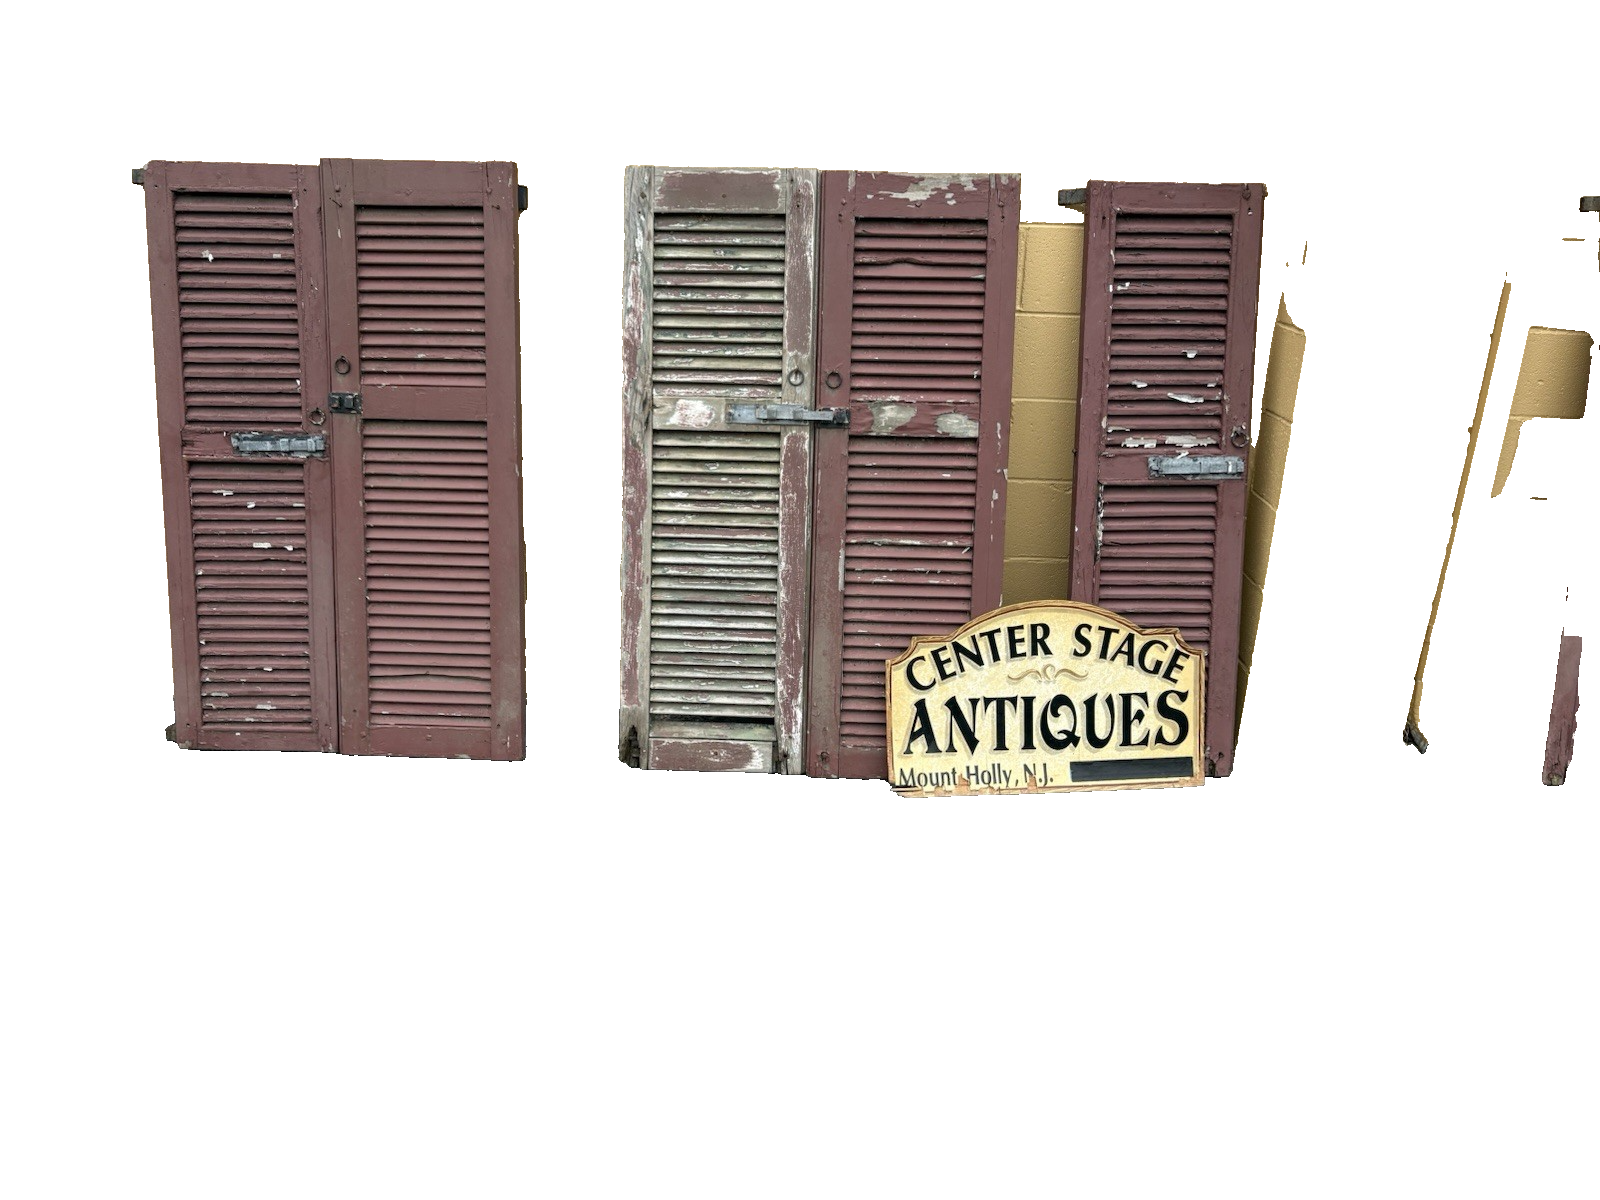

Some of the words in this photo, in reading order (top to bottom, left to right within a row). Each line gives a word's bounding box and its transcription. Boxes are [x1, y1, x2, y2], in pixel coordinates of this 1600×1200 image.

[906, 622, 1052, 691] CENTER
[1073, 623, 1190, 684] STAGE
[903, 689, 1190, 755] ANTIQUES
[899, 766, 957, 788] Mount
[966, 763, 1019, 787] Holly,
[1022, 763, 1054, 786] N.J.
